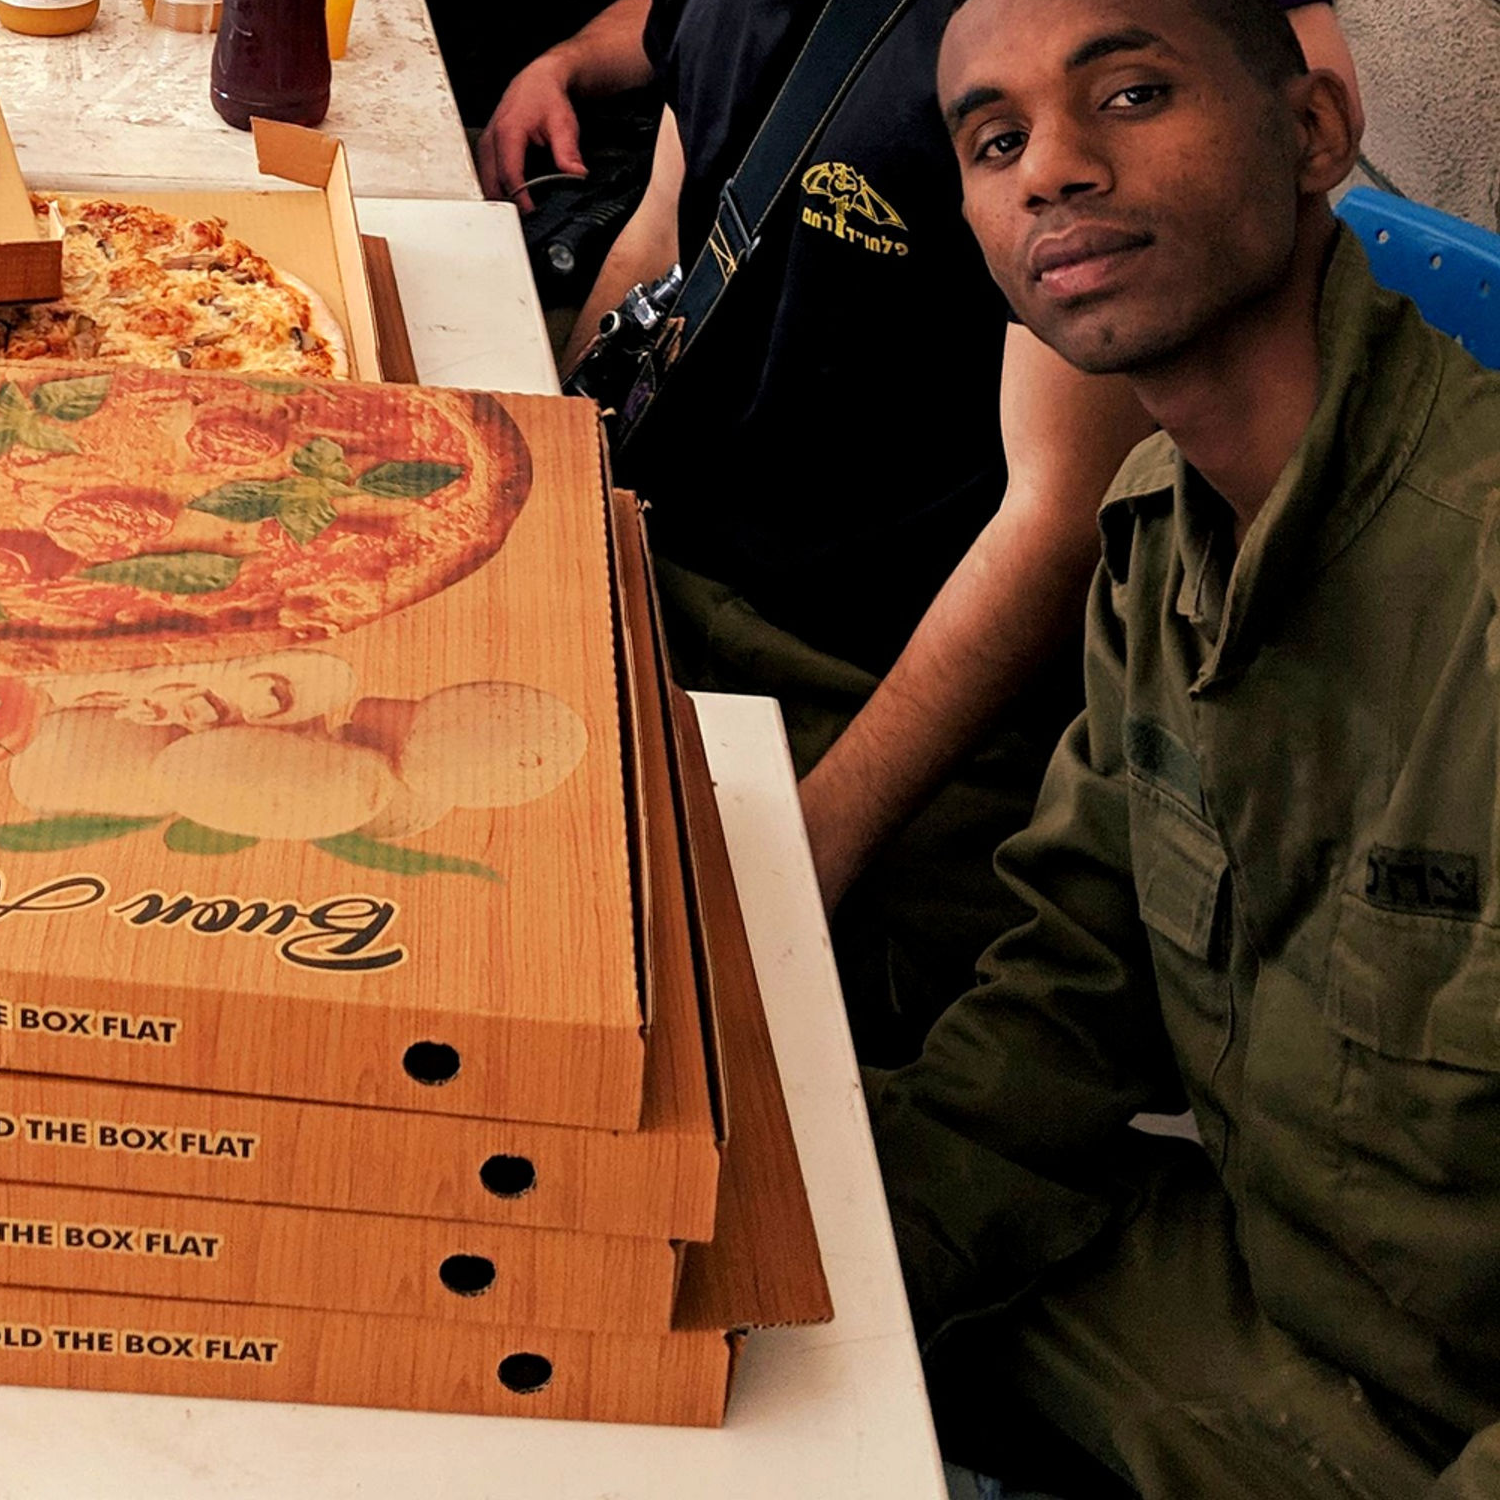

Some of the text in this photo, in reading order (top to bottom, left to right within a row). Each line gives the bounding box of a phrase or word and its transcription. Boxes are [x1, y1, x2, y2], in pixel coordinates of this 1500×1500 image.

[116, 896, 404, 971] Buon
[20, 1008, 91, 1035] BOX
[102, 1016, 177, 1043] FLAT
[26, 1119, 87, 1144] THE
[99, 1126, 168, 1151] BOX
[181, 1132, 255, 1158] FLAT
[65, 1227, 134, 1251] BOX
[145, 1233, 218, 1258] FLAT
[54, 1330, 113, 1352] THE
[125, 1334, 194, 1357] BOX
[205, 1339, 278, 1363] FLAT
